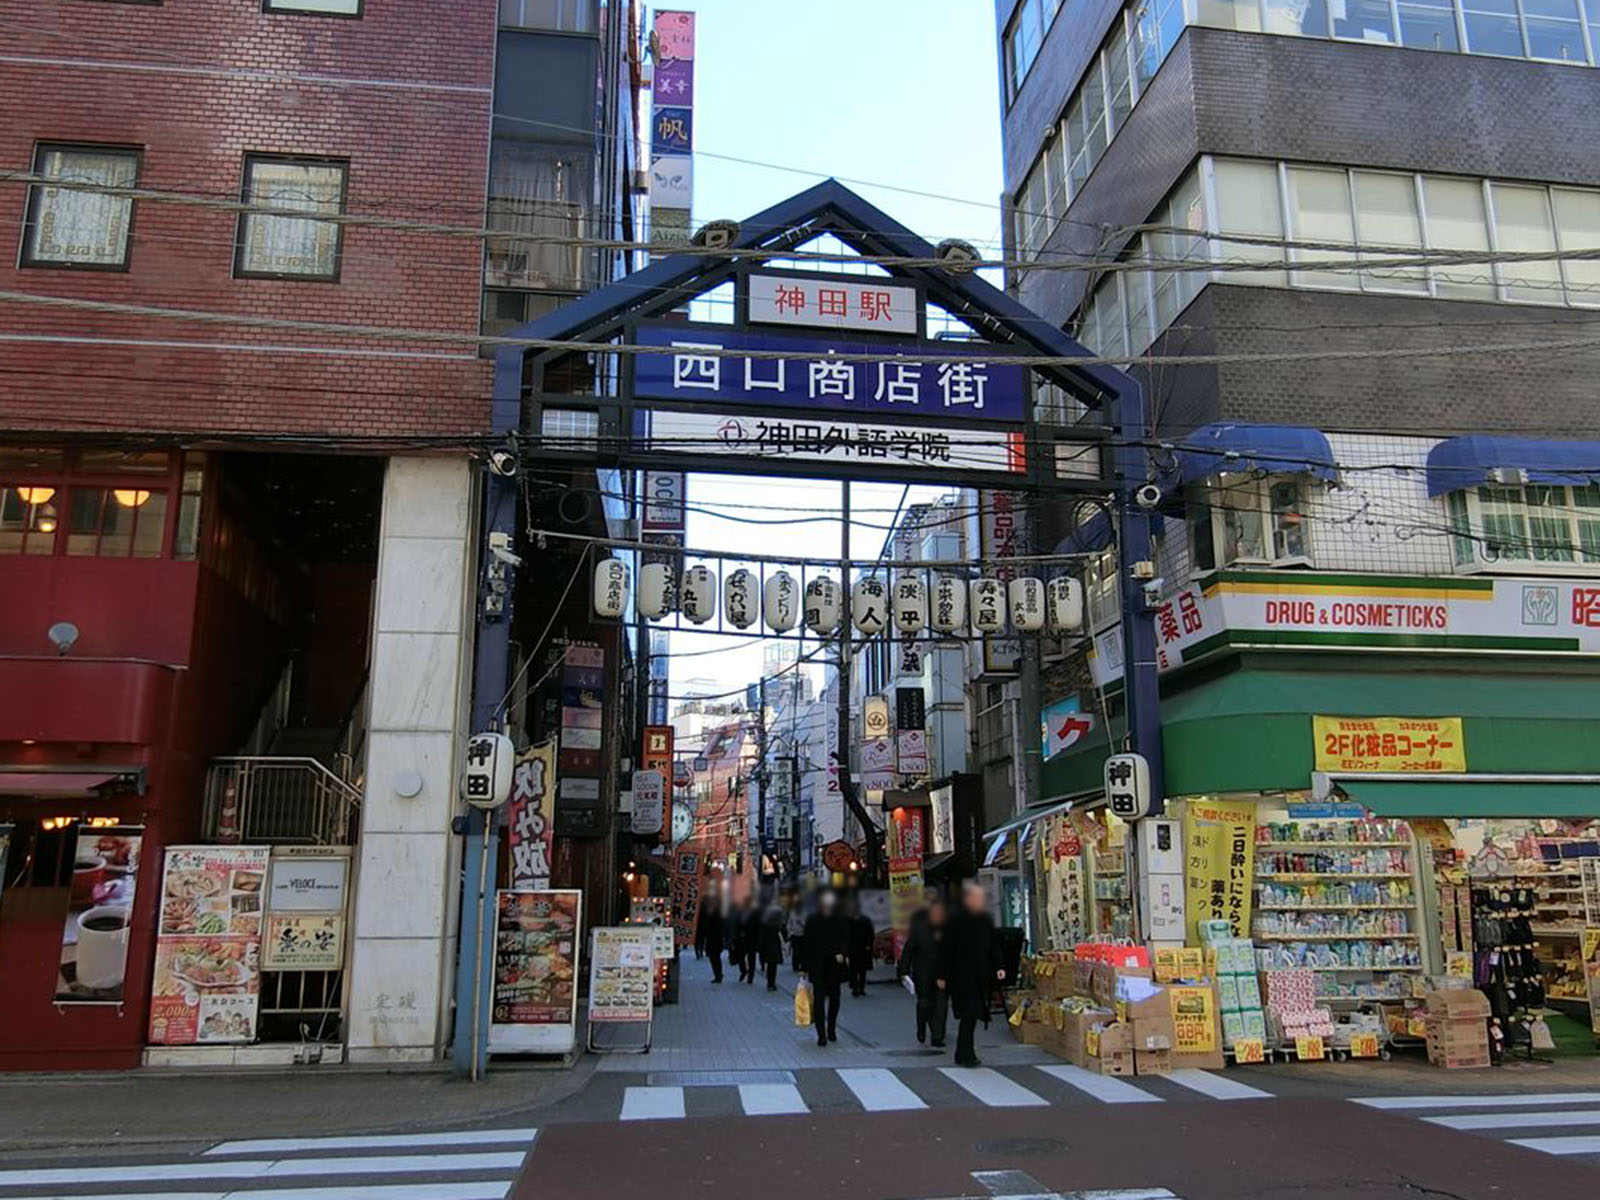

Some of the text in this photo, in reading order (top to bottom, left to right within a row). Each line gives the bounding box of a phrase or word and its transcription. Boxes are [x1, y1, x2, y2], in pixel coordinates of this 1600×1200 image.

[774, 284, 893, 322] 神田駅
[671, 341, 988, 409] 西口商店街
[755, 420, 950, 463] 神田外語学院
[860, 581, 883, 625] 海人
[900, 584, 920, 625] 淡平
[979, 581, 998, 625] 寿々屋
[1266, 600, 1447, 629] DRUG & COSMETICKS
[467, 738, 493, 796] 神田
[1325, 733, 1453, 758] 2F化粧品コーナー
[1109, 761, 1134, 813] 神田
[1198, 837, 1209, 910] ドリンク
